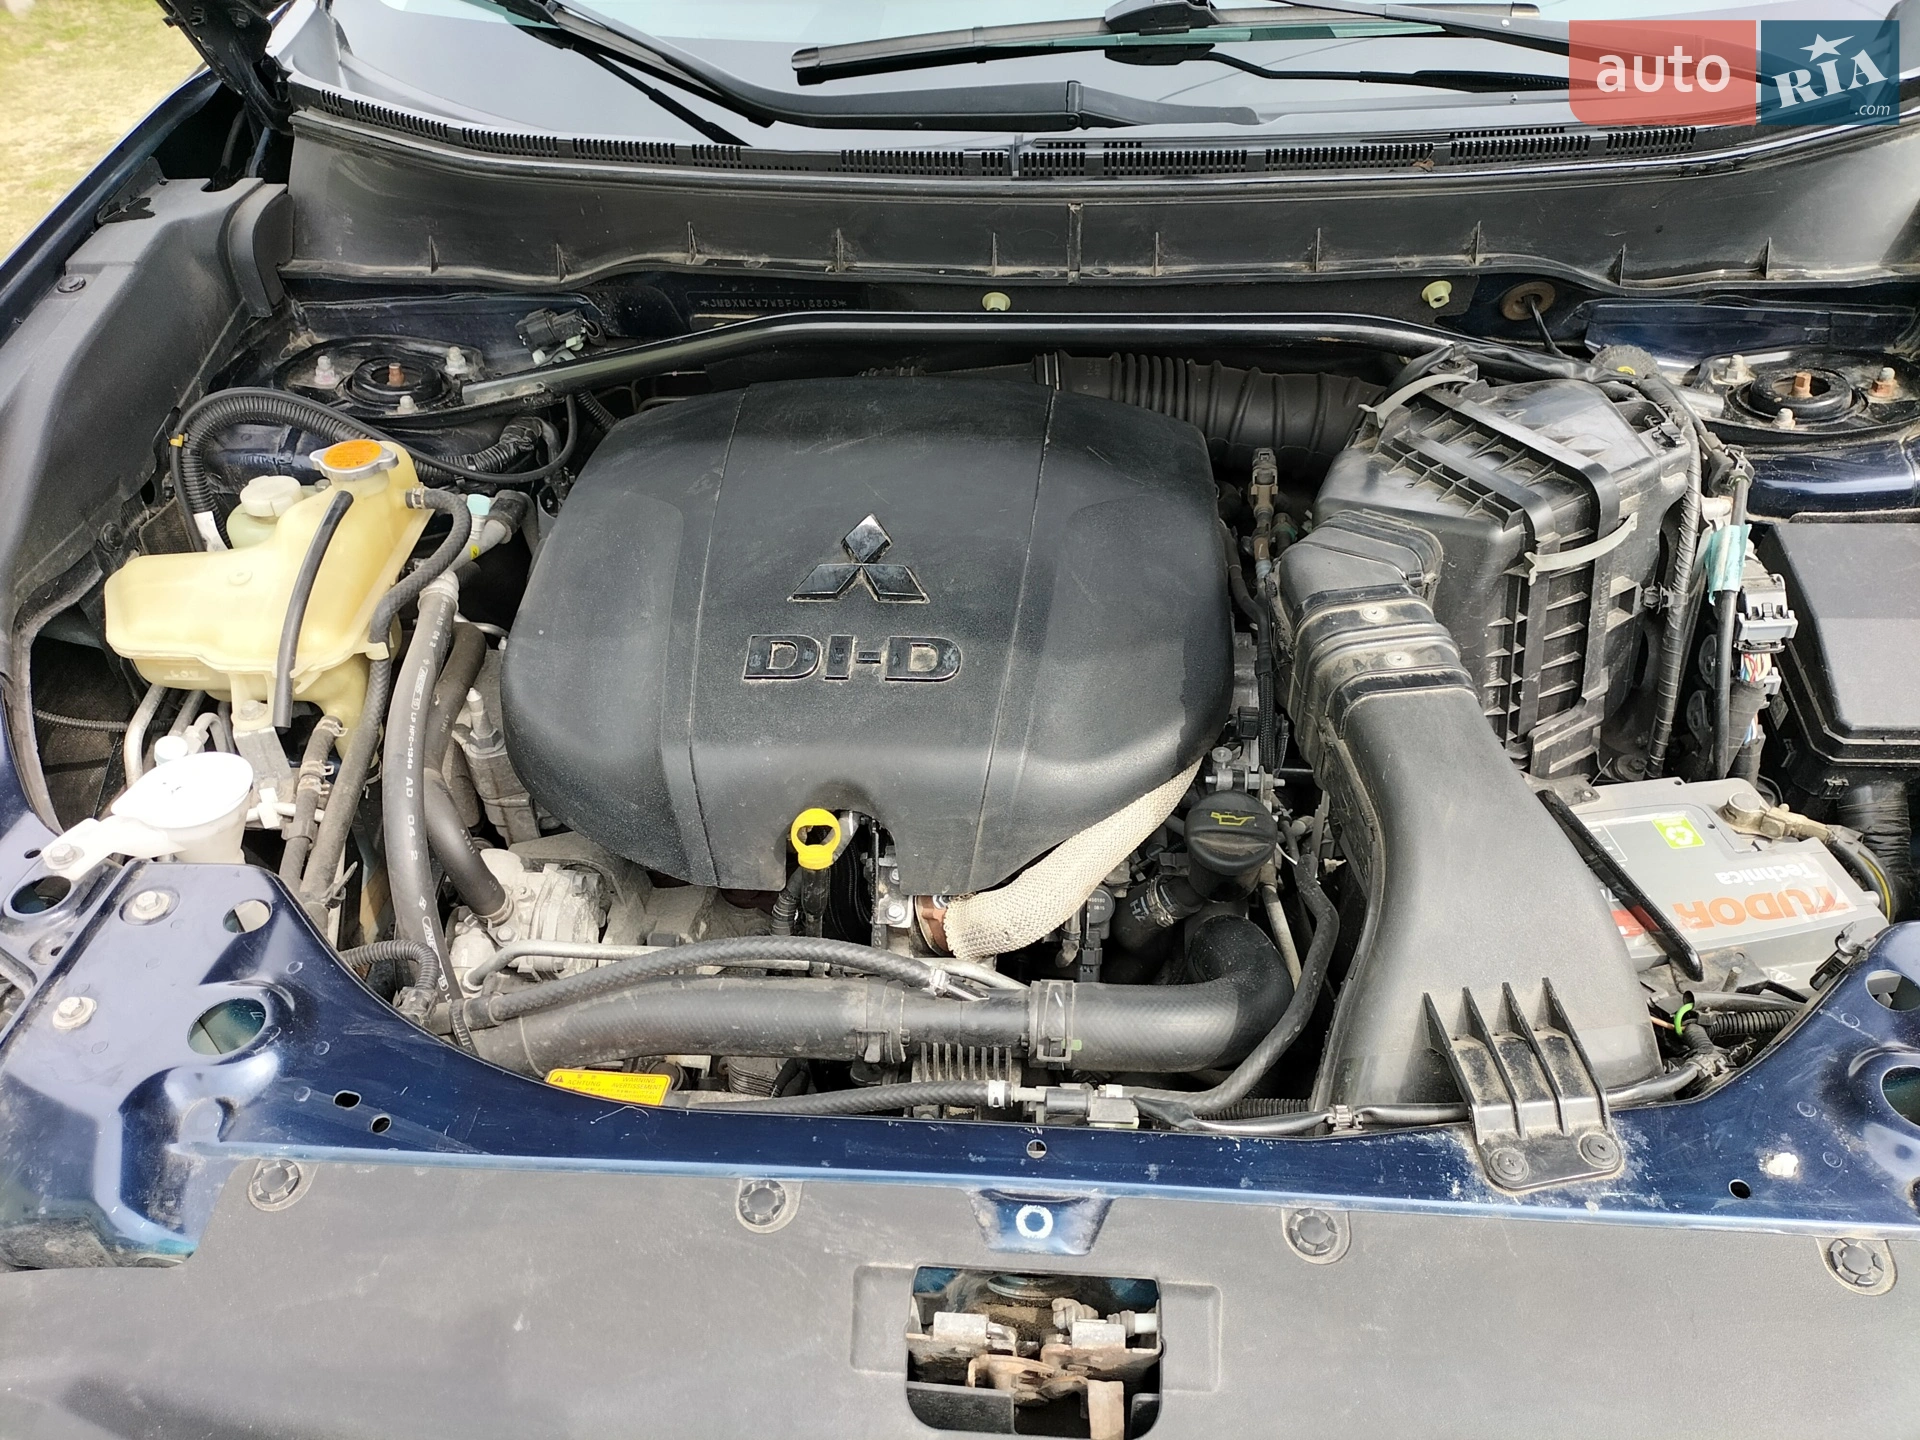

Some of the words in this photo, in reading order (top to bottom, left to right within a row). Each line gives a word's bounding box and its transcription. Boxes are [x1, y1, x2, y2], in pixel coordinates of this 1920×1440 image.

[743, 634, 962, 684] DI-D
[405, 776, 414, 798] AD
[407, 814, 416, 838] 04
[410, 850, 418, 861] 2
[1714, 863, 1819, 886] Technica
[1672, 886, 1849, 930] TUDOR
